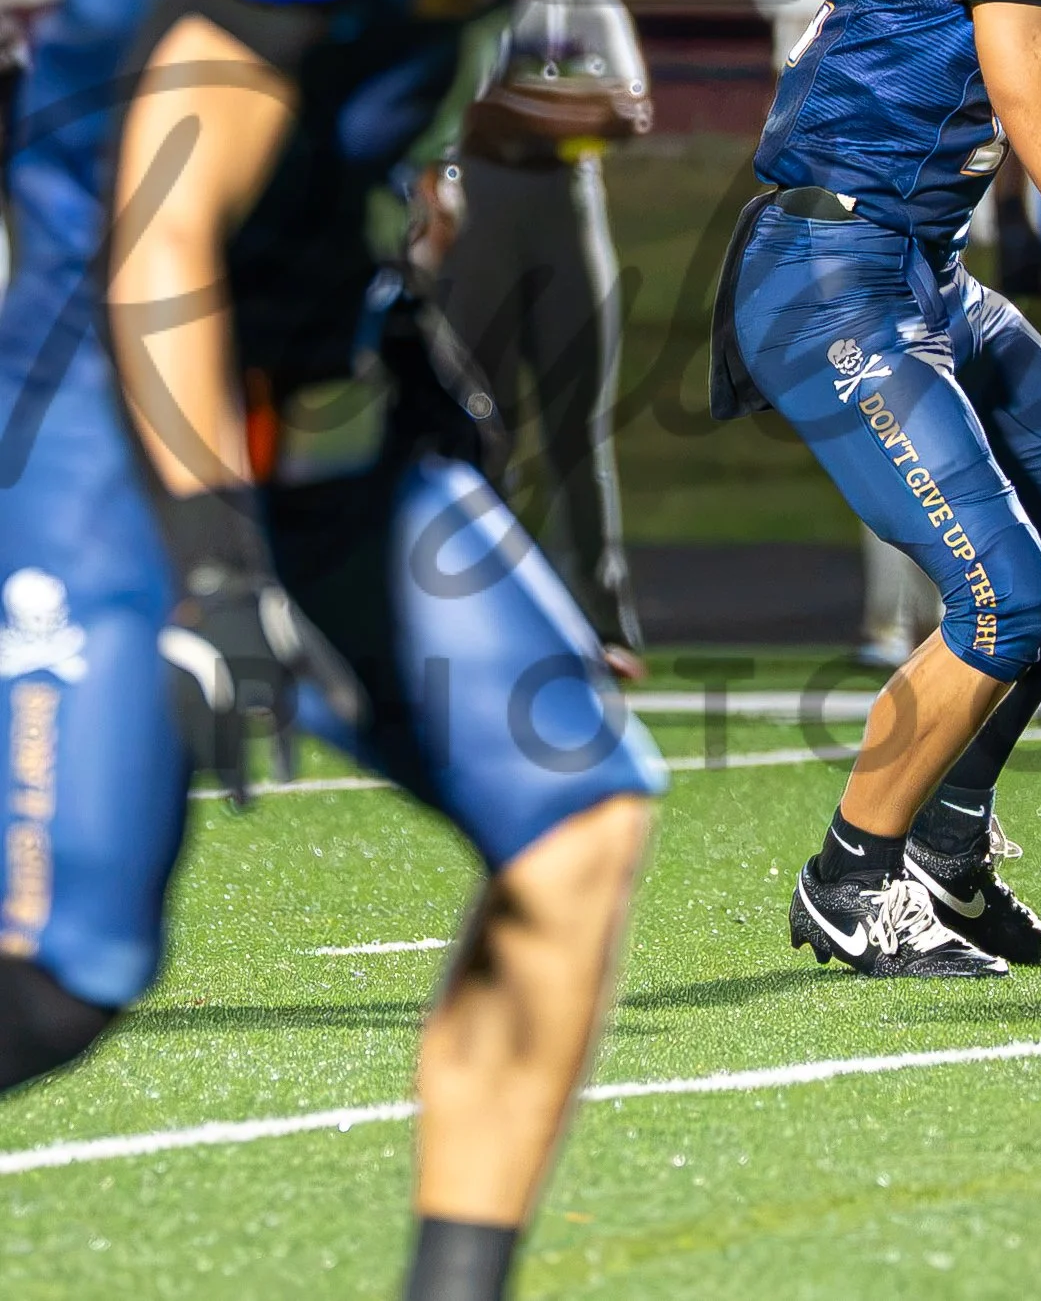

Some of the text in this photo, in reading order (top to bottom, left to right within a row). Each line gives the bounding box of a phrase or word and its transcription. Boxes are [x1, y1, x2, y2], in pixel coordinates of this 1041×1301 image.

[859, 391, 998, 657] DON'T GIVE UP THE SHI
